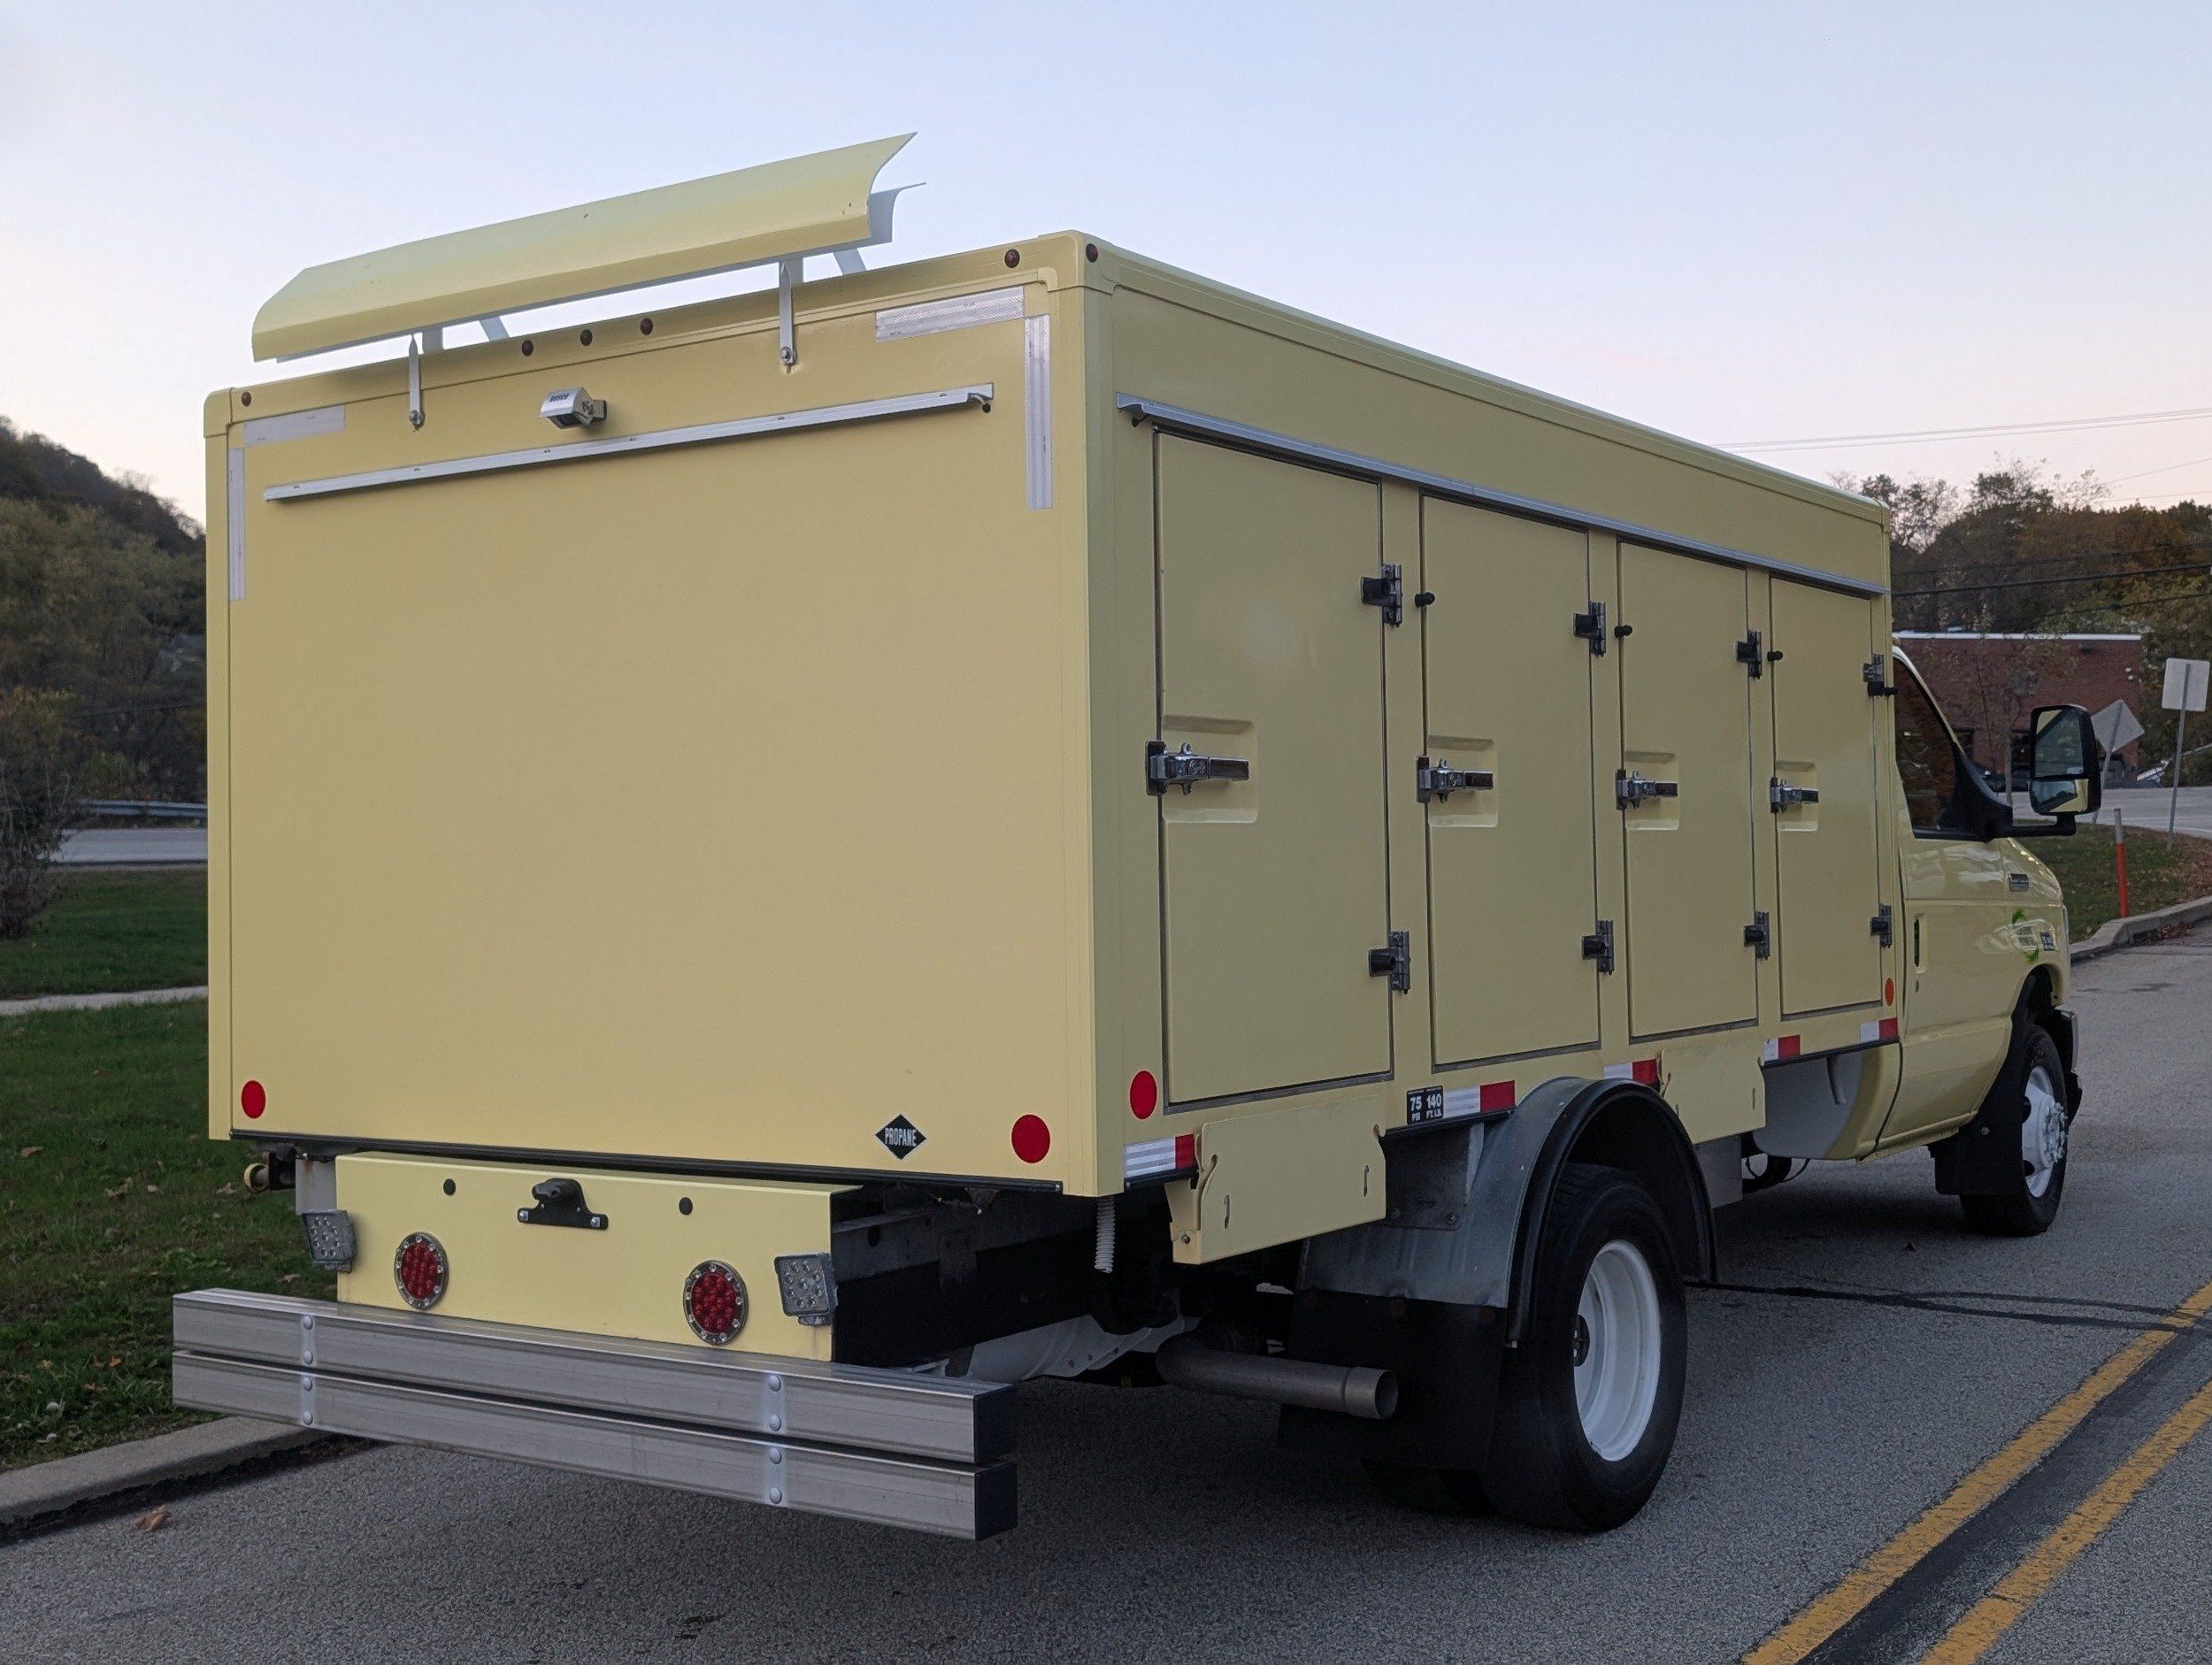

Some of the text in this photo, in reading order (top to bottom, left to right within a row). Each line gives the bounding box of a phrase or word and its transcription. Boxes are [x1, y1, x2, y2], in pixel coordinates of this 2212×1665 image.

[1410, 1096, 1422, 1111] 75
[1426, 1093, 1441, 1109] 140
[885, 1128, 917, 1147] PROPANE
